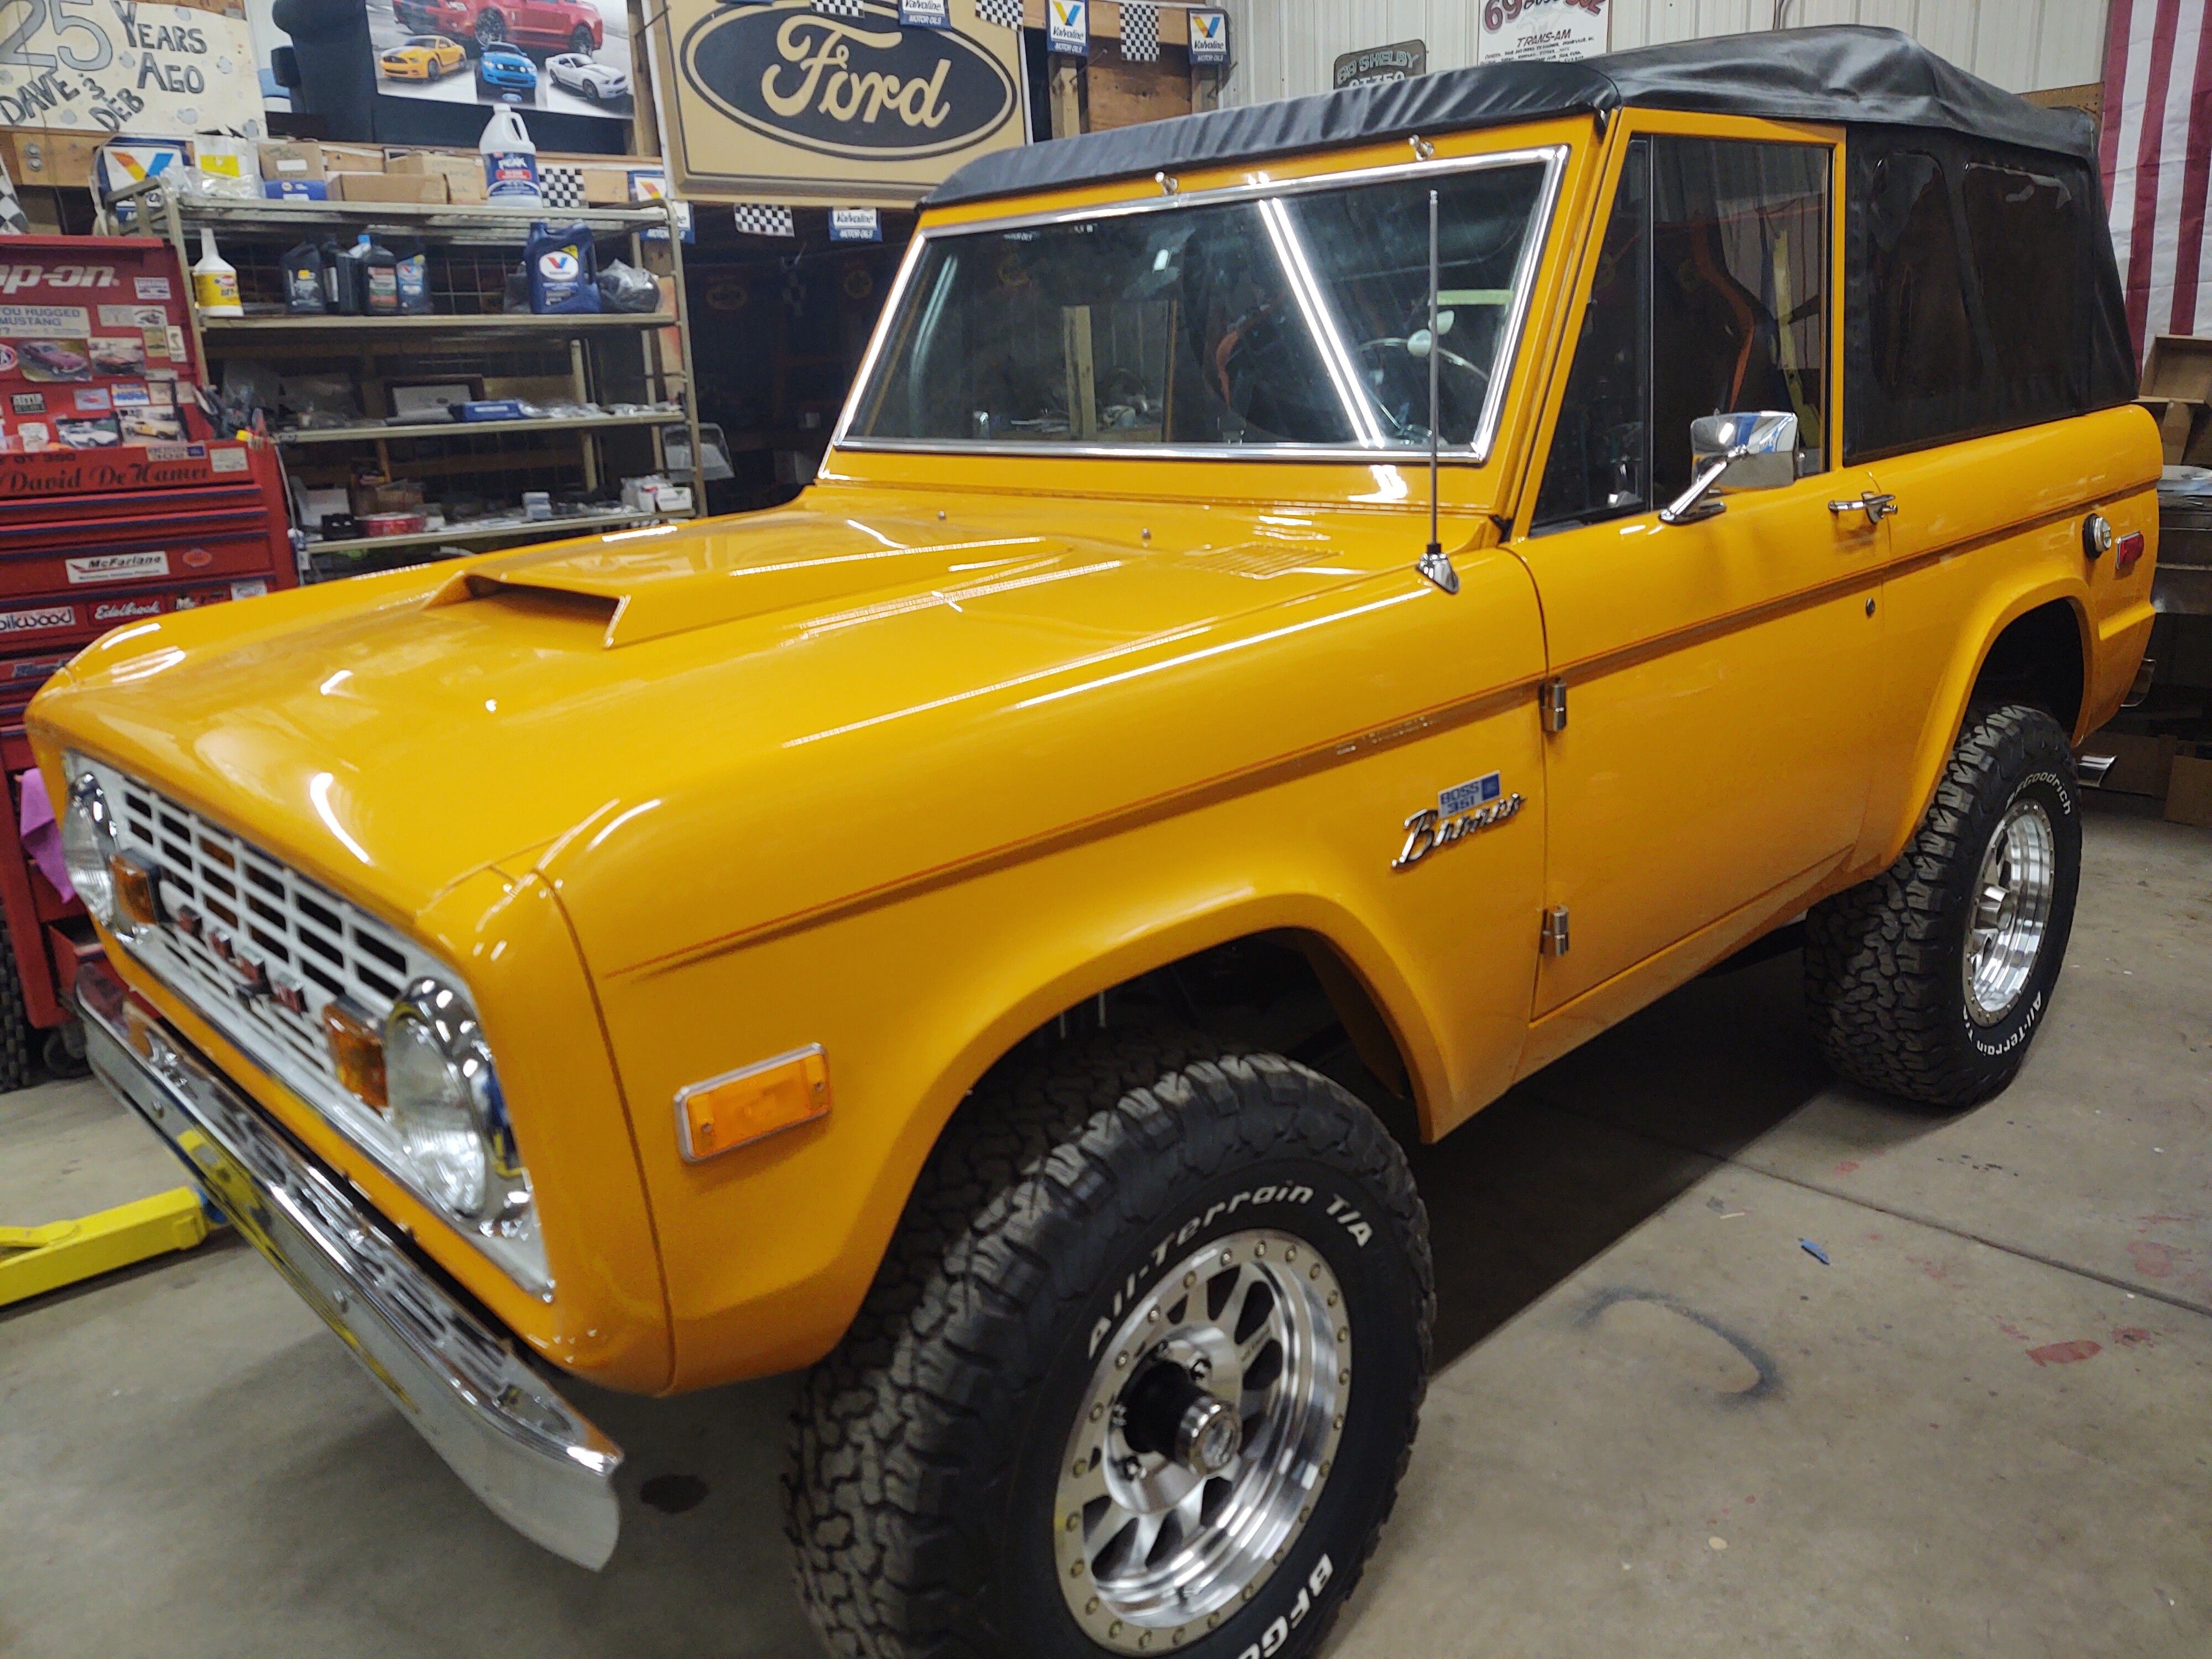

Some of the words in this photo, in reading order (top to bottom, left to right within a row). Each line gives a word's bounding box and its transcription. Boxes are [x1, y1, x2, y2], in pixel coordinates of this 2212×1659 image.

[0, 0, 112, 71] 25
[113, 1, 207, 54] YEARS
[1053, 25, 1084, 40] Valvoline
[1194, 40, 1224, 49] Valvoline
[1517, 29, 1571, 48] TRANS-AM
[137, 53, 204, 93] AGO
[761, 14, 952, 128] Ford
[1359, 50, 1420, 72] SHELBY
[0, 66, 80, 125] DAVE
[88, 88, 145, 132] DEB
[0, 264, 115, 295] p-on
[25, 308, 81, 318] HUGGED
[88, 555, 161, 568] McFarlane
[1441, 781, 1480, 806] BOSS
[1976, 990, 2042, 1057] All-Terrain
[1087, 1178, 1314, 1360] All-Terrain
